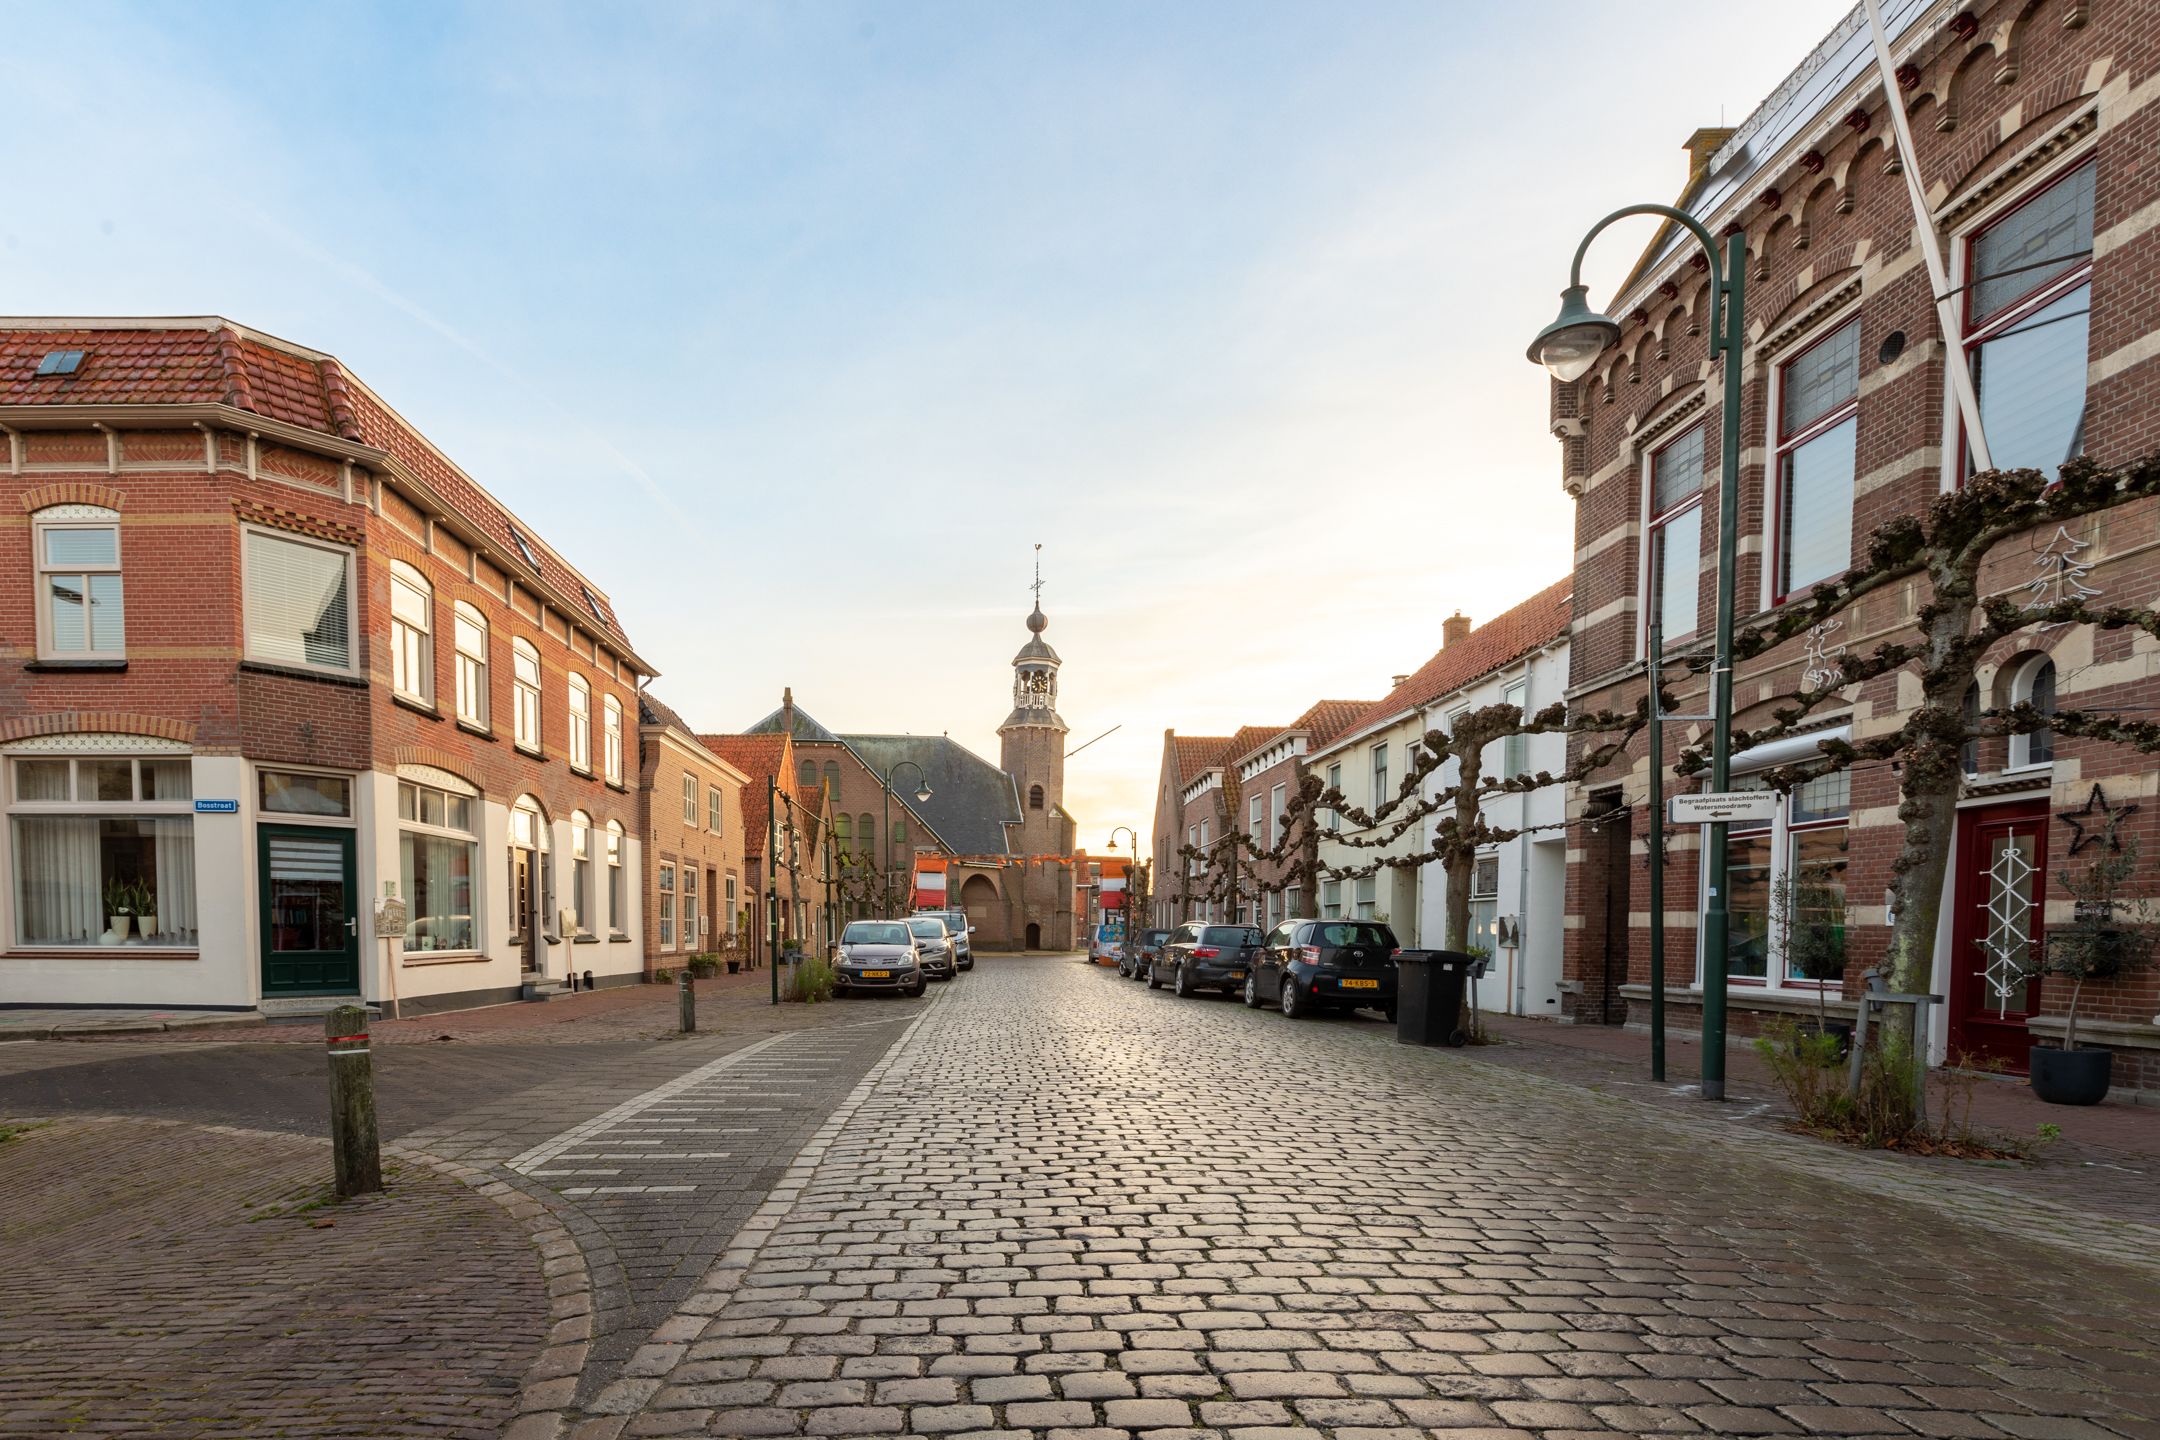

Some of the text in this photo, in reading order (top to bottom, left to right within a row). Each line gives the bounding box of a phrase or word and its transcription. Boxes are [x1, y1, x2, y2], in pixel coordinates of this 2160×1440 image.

[1678, 794, 1770, 805] Begraafplaats slachtoffers
[1694, 803, 1752, 811] Watersnoodramp
